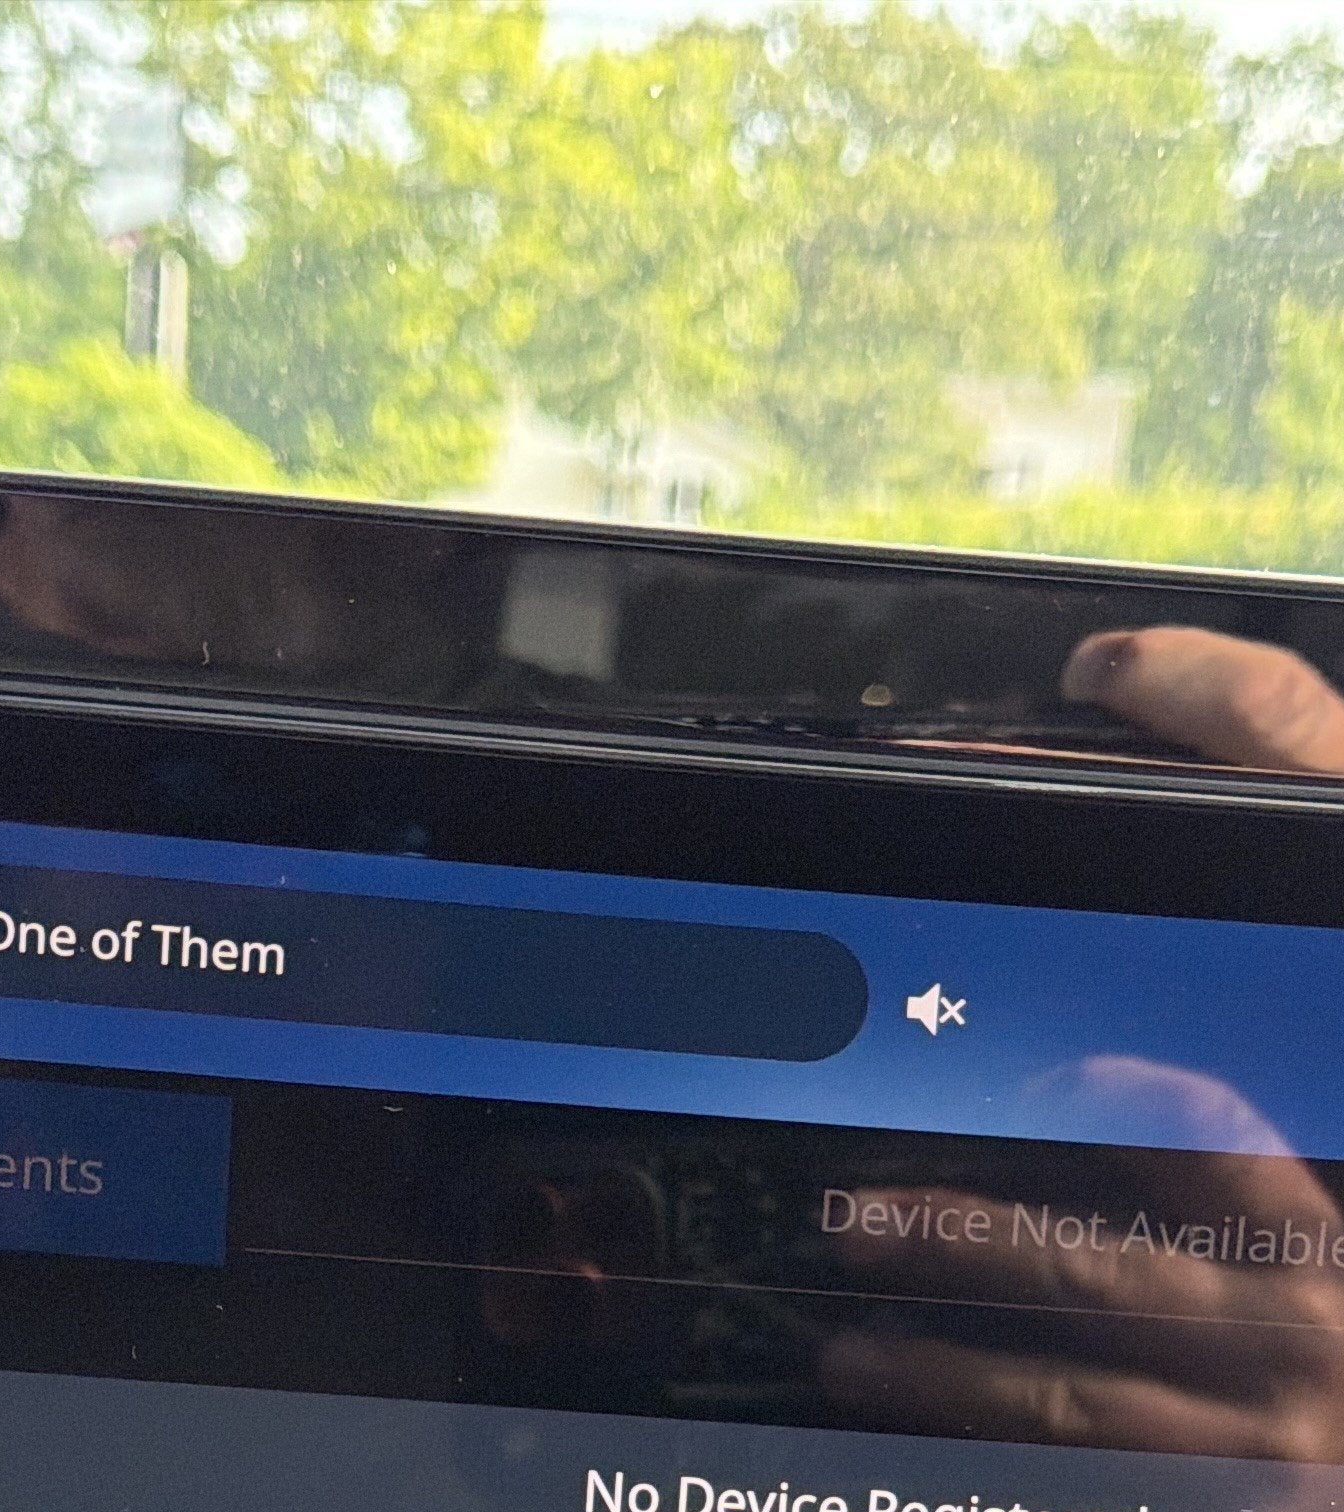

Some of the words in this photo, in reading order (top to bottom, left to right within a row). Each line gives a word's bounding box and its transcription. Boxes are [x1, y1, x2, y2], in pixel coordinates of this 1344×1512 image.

[91, 919, 143, 963] of
[150, 923, 285, 976] Them
[822, 1189, 993, 1244] Device
[1010, 1203, 1109, 1254] Not
